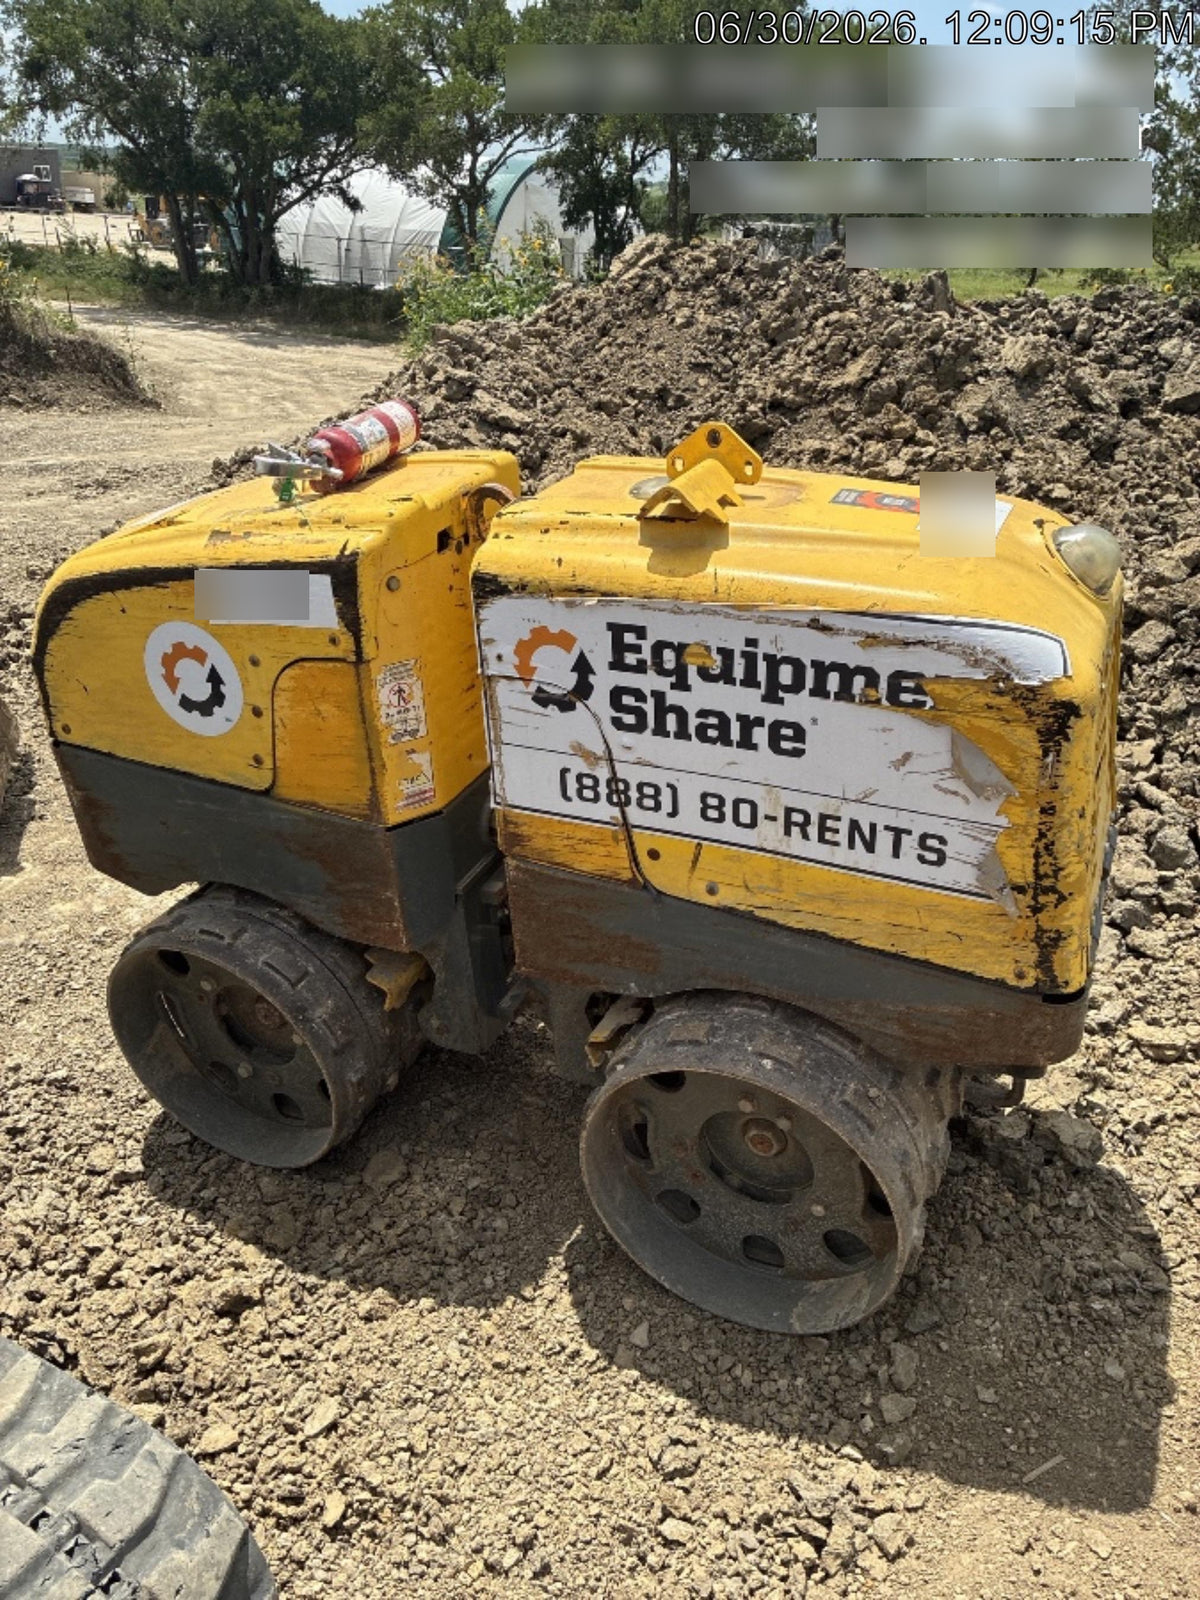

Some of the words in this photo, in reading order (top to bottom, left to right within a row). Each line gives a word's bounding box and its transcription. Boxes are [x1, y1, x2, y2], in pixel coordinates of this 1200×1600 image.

[609, 684, 807, 758] Share
[559, 766, 680, 818] (888)
[700, 792, 948, 867] 80-RENTS
